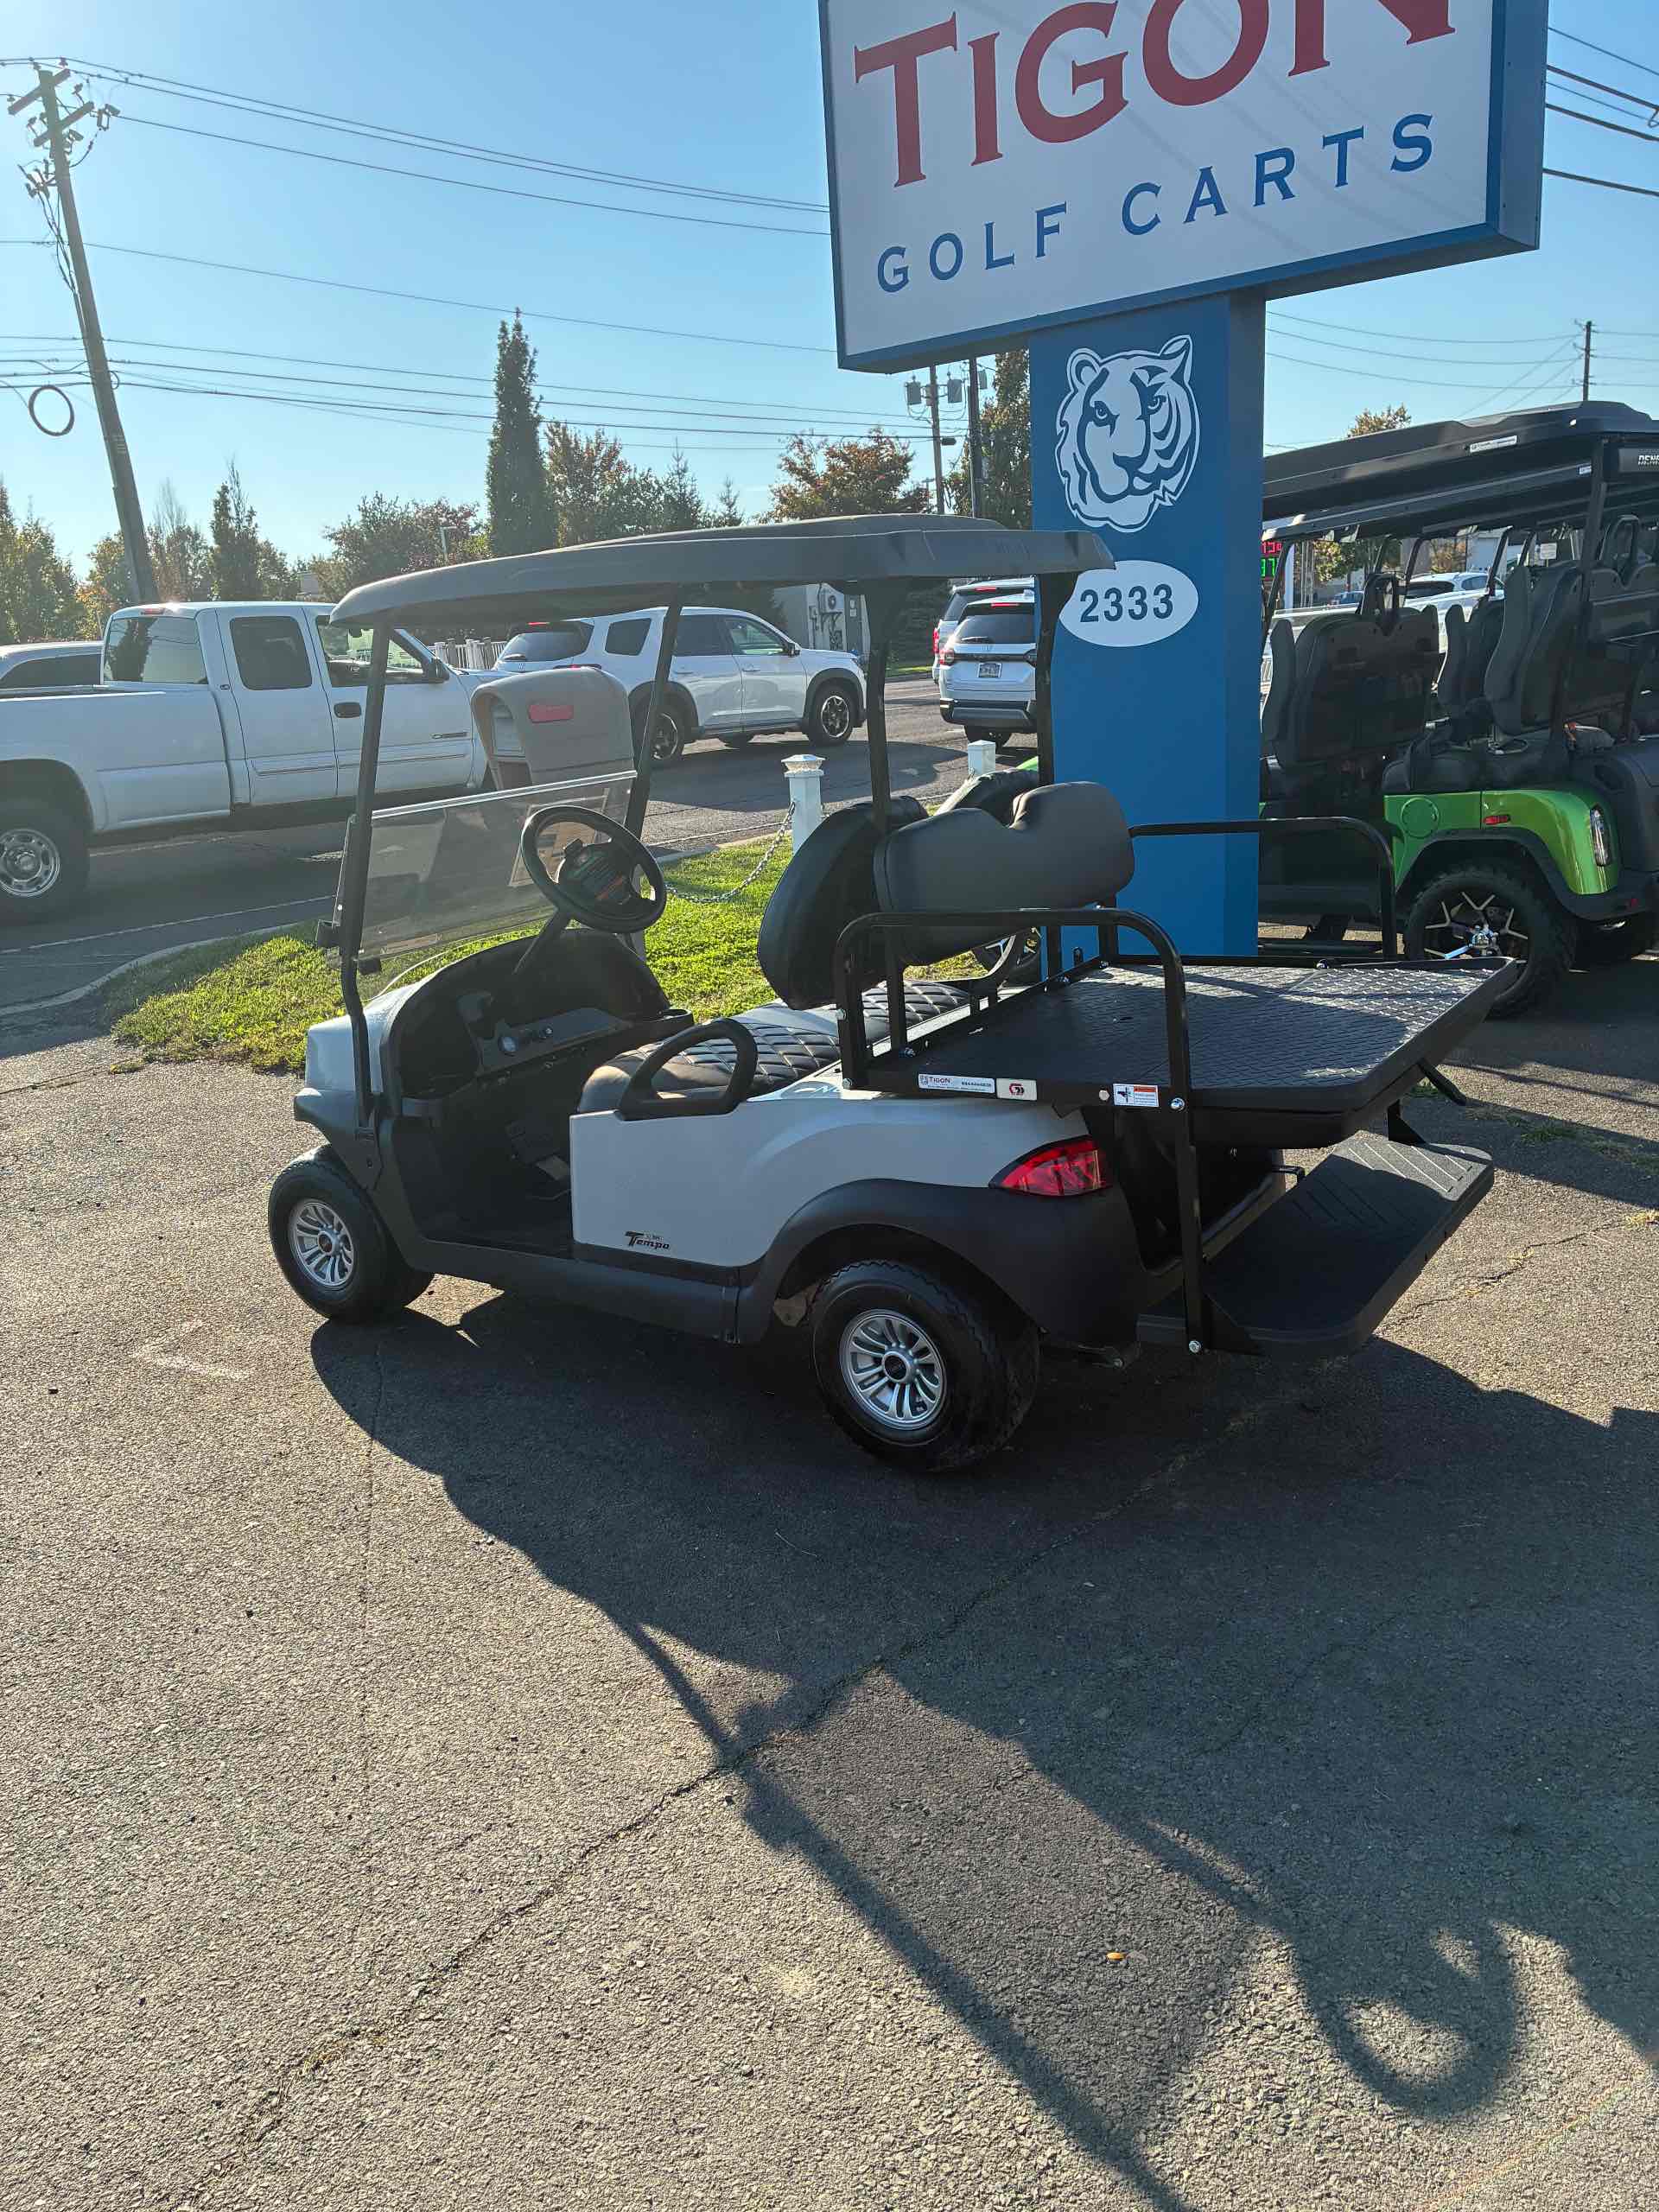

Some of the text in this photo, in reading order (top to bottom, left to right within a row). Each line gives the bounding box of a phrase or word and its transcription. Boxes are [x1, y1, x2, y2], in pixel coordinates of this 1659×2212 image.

[877, 113, 1433, 293] GOLF CARTS
[1080, 583, 1173, 622] 2333
[625, 1230, 670, 1249] Tempo
